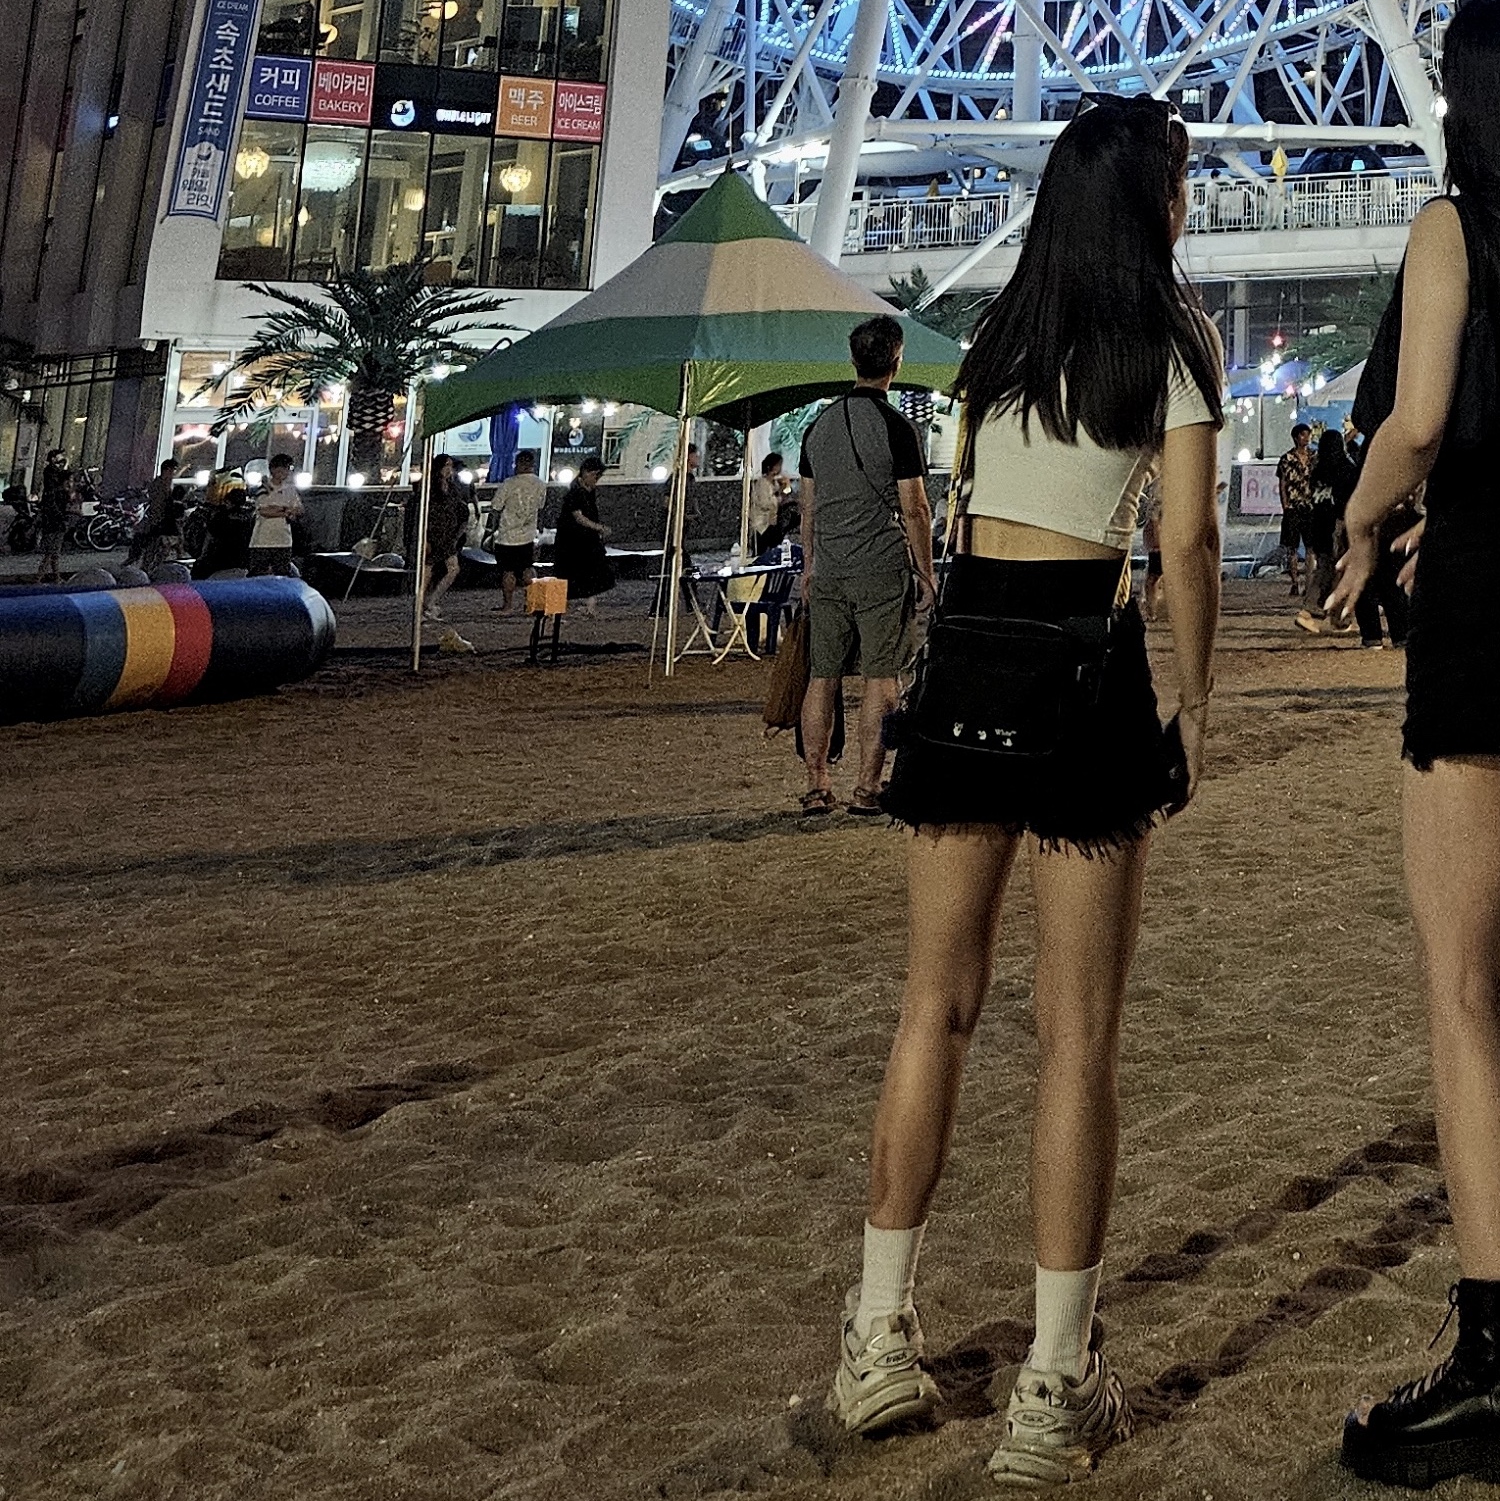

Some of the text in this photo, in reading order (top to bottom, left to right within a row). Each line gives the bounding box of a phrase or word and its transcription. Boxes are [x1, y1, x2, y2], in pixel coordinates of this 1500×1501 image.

[199, 19, 240, 125] 속초샌드
[260, 67, 300, 91] 커피
[318, 72, 370, 97] 베이커리
[254, 93, 300, 109] COFFEE
[318, 99, 365, 114] BAKERY
[508, 87, 545, 110] 맥주
[558, 92, 602, 115] 아이스크림
[510, 115, 538, 127] BEER
[557, 118, 601, 132] ICE CREAM
[187, 193, 211, 209] 라잇
